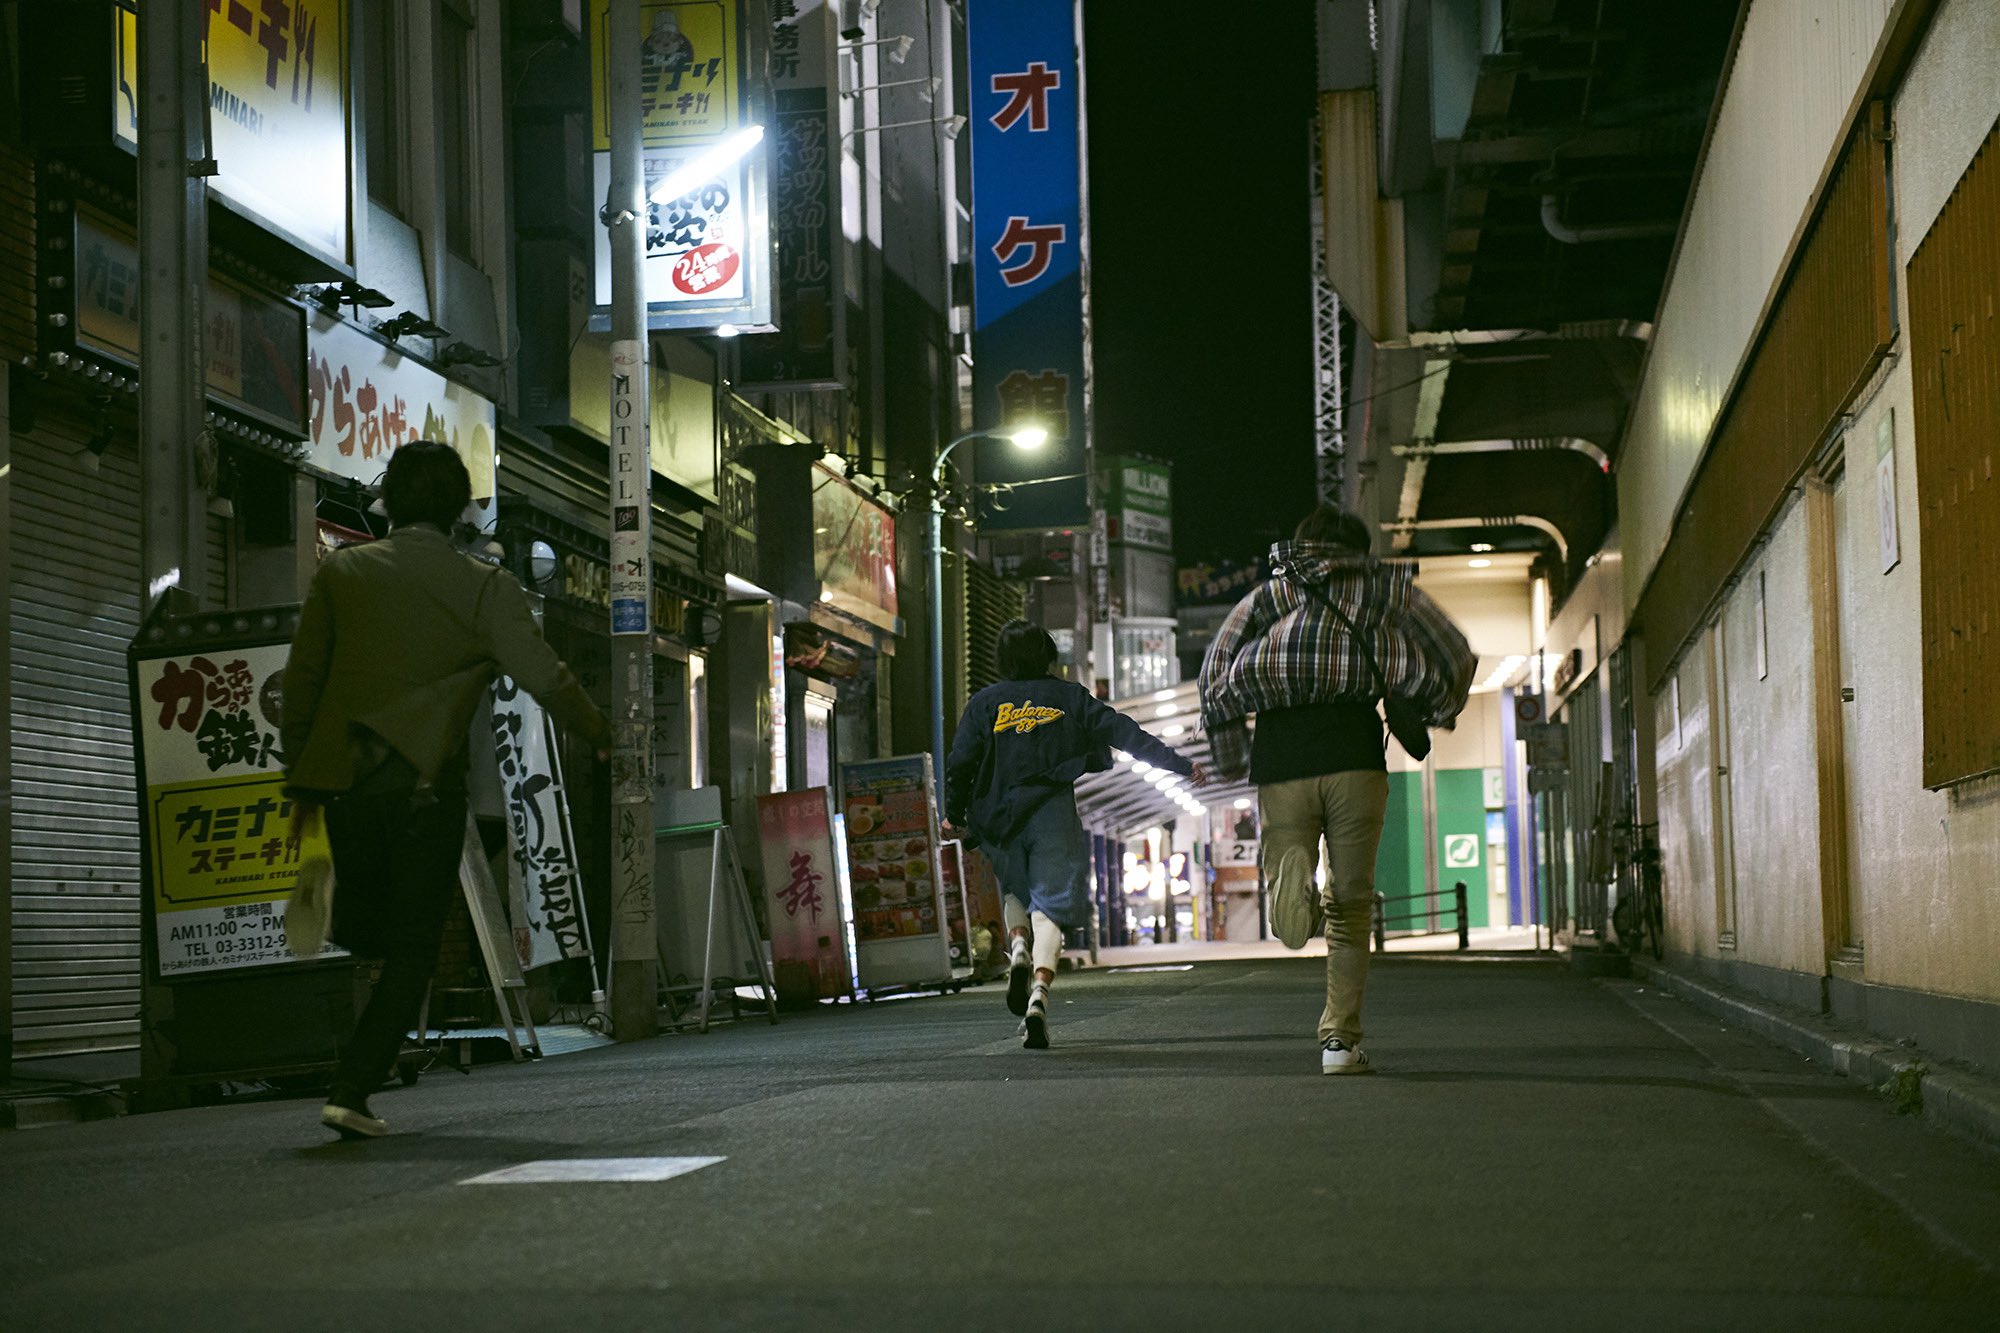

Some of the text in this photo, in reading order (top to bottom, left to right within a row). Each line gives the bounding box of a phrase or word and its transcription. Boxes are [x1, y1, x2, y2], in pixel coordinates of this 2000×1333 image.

[188, 837, 282, 874] ステーキ
[223, 902, 272, 920] 営業時間
[170, 921, 237, 941] AM11:00
[185, 943, 209, 957] TEL
